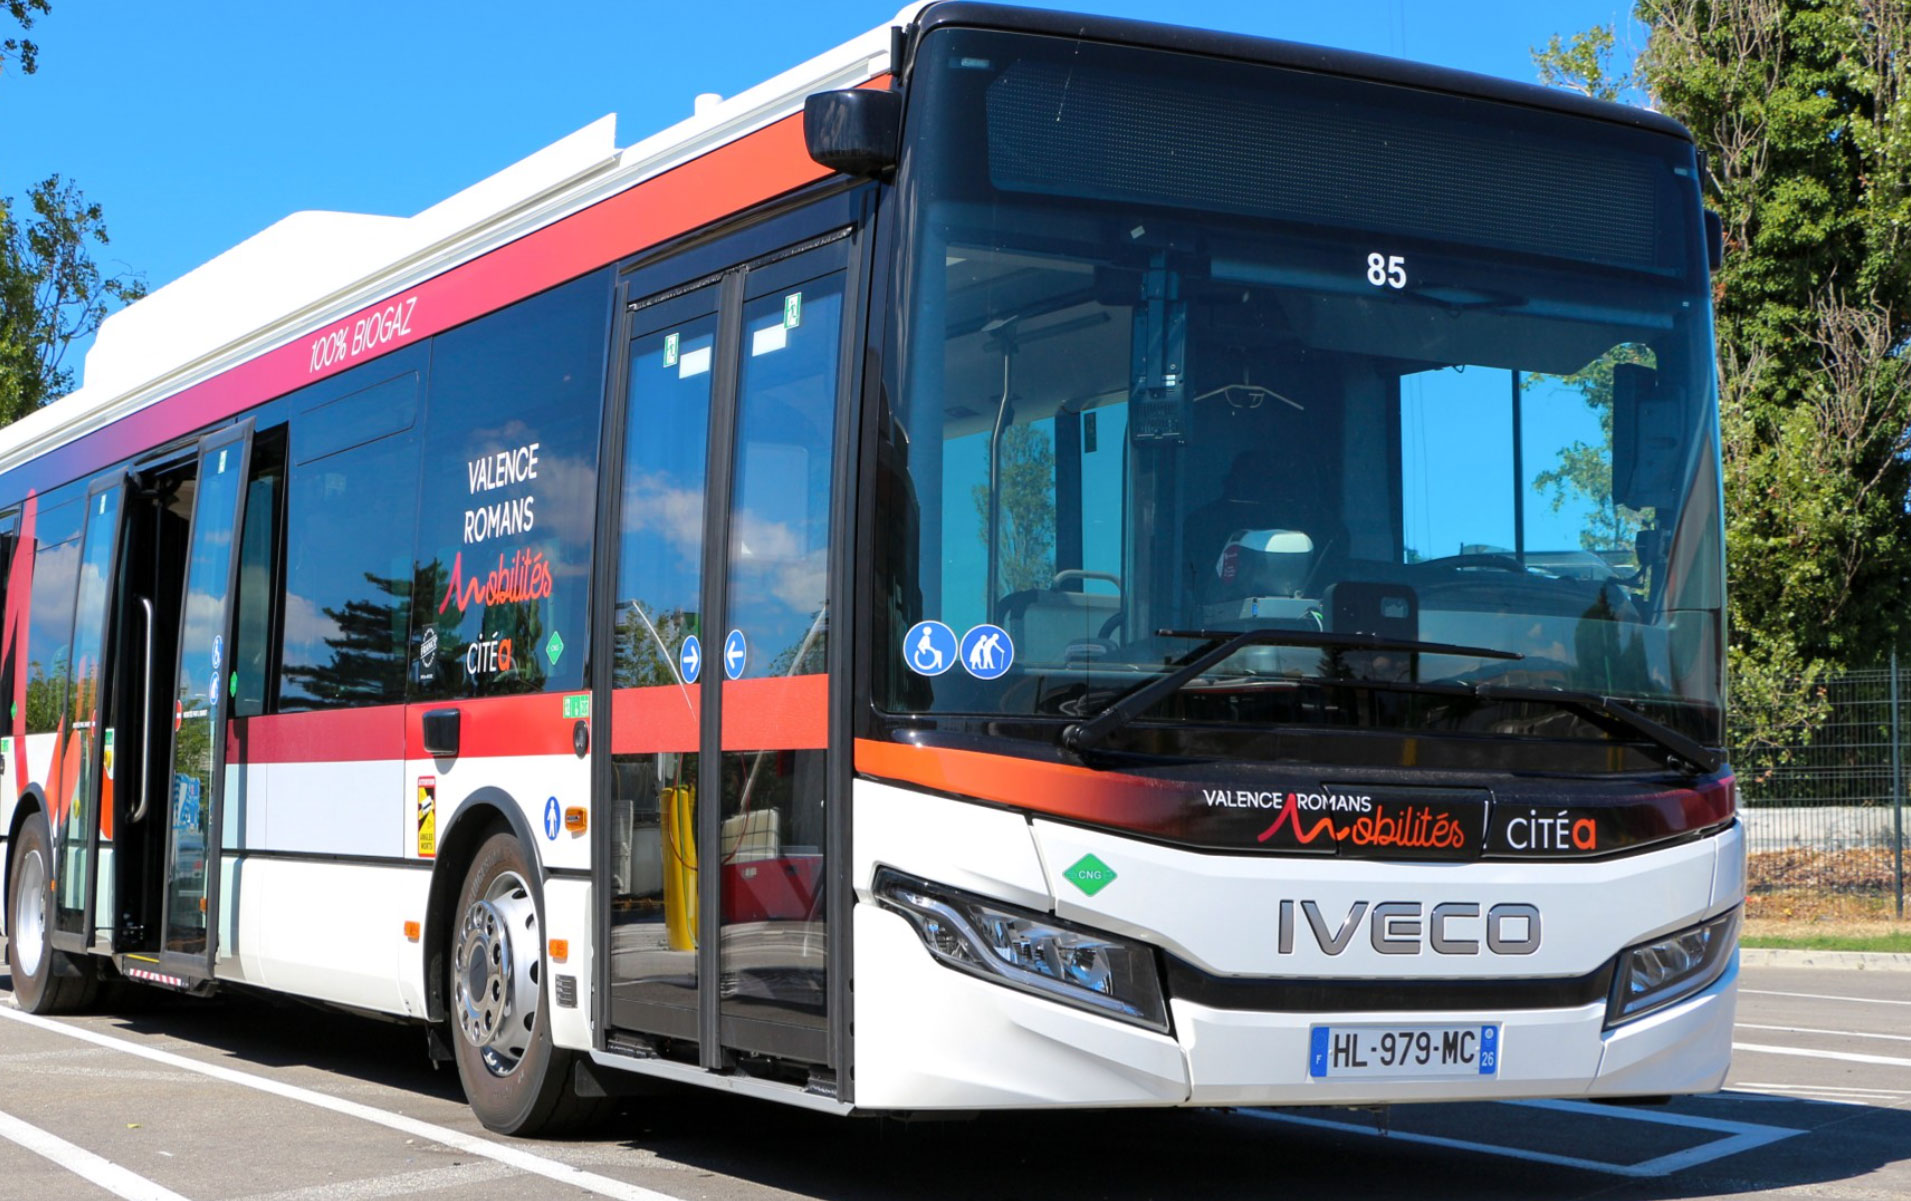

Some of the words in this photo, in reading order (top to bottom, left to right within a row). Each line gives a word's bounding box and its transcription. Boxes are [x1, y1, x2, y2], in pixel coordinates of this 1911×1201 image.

[1367, 252, 1407, 289] 85
[309, 326, 349, 374] 100%
[351, 296, 418, 356] BIOGAZ
[468, 442, 540, 495] VALENCE
[464, 496, 534, 544] ROMANS
[438, 547, 553, 615] Mobilités
[1202, 789, 1283, 810] VALENCE
[1296, 793, 1372, 813] ROMANS
[1257, 792, 1464, 849] Mobilités
[1078, 870, 1102, 880] CNG
[1278, 899, 1542, 956] IVECO
[1315, 1054, 1322, 1065] F
[1333, 1030, 1476, 1068] HL-979-MC
[1481, 1051, 1495, 1067] 26
